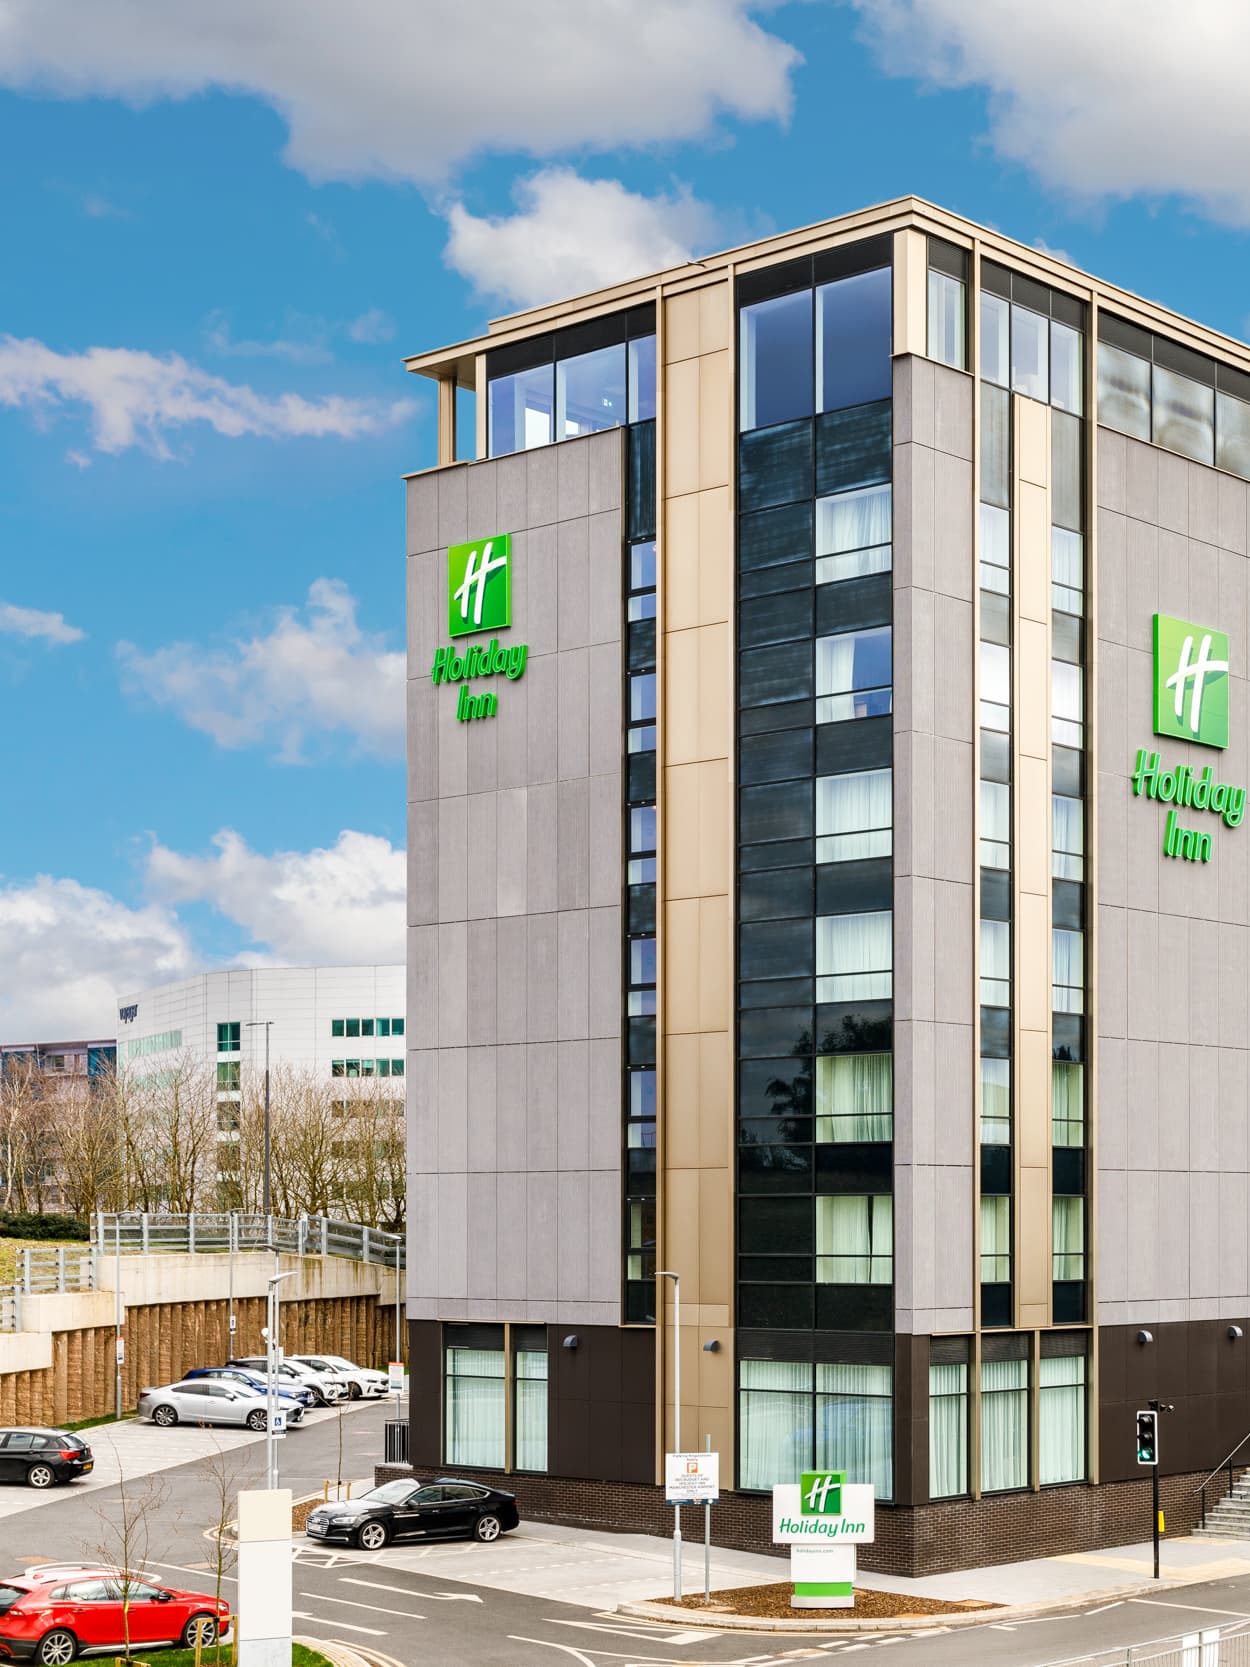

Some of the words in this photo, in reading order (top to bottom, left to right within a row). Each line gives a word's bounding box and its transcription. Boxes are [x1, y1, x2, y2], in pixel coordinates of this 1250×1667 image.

[431, 638, 529, 686] Holiday
[456, 684, 498, 722] Inn
[1131, 748, 1247, 828] Holiday
[1163, 809, 1213, 863] Inn
[779, 1518, 839, 1538] Holiday
[840, 1518, 865, 1534] Inn
